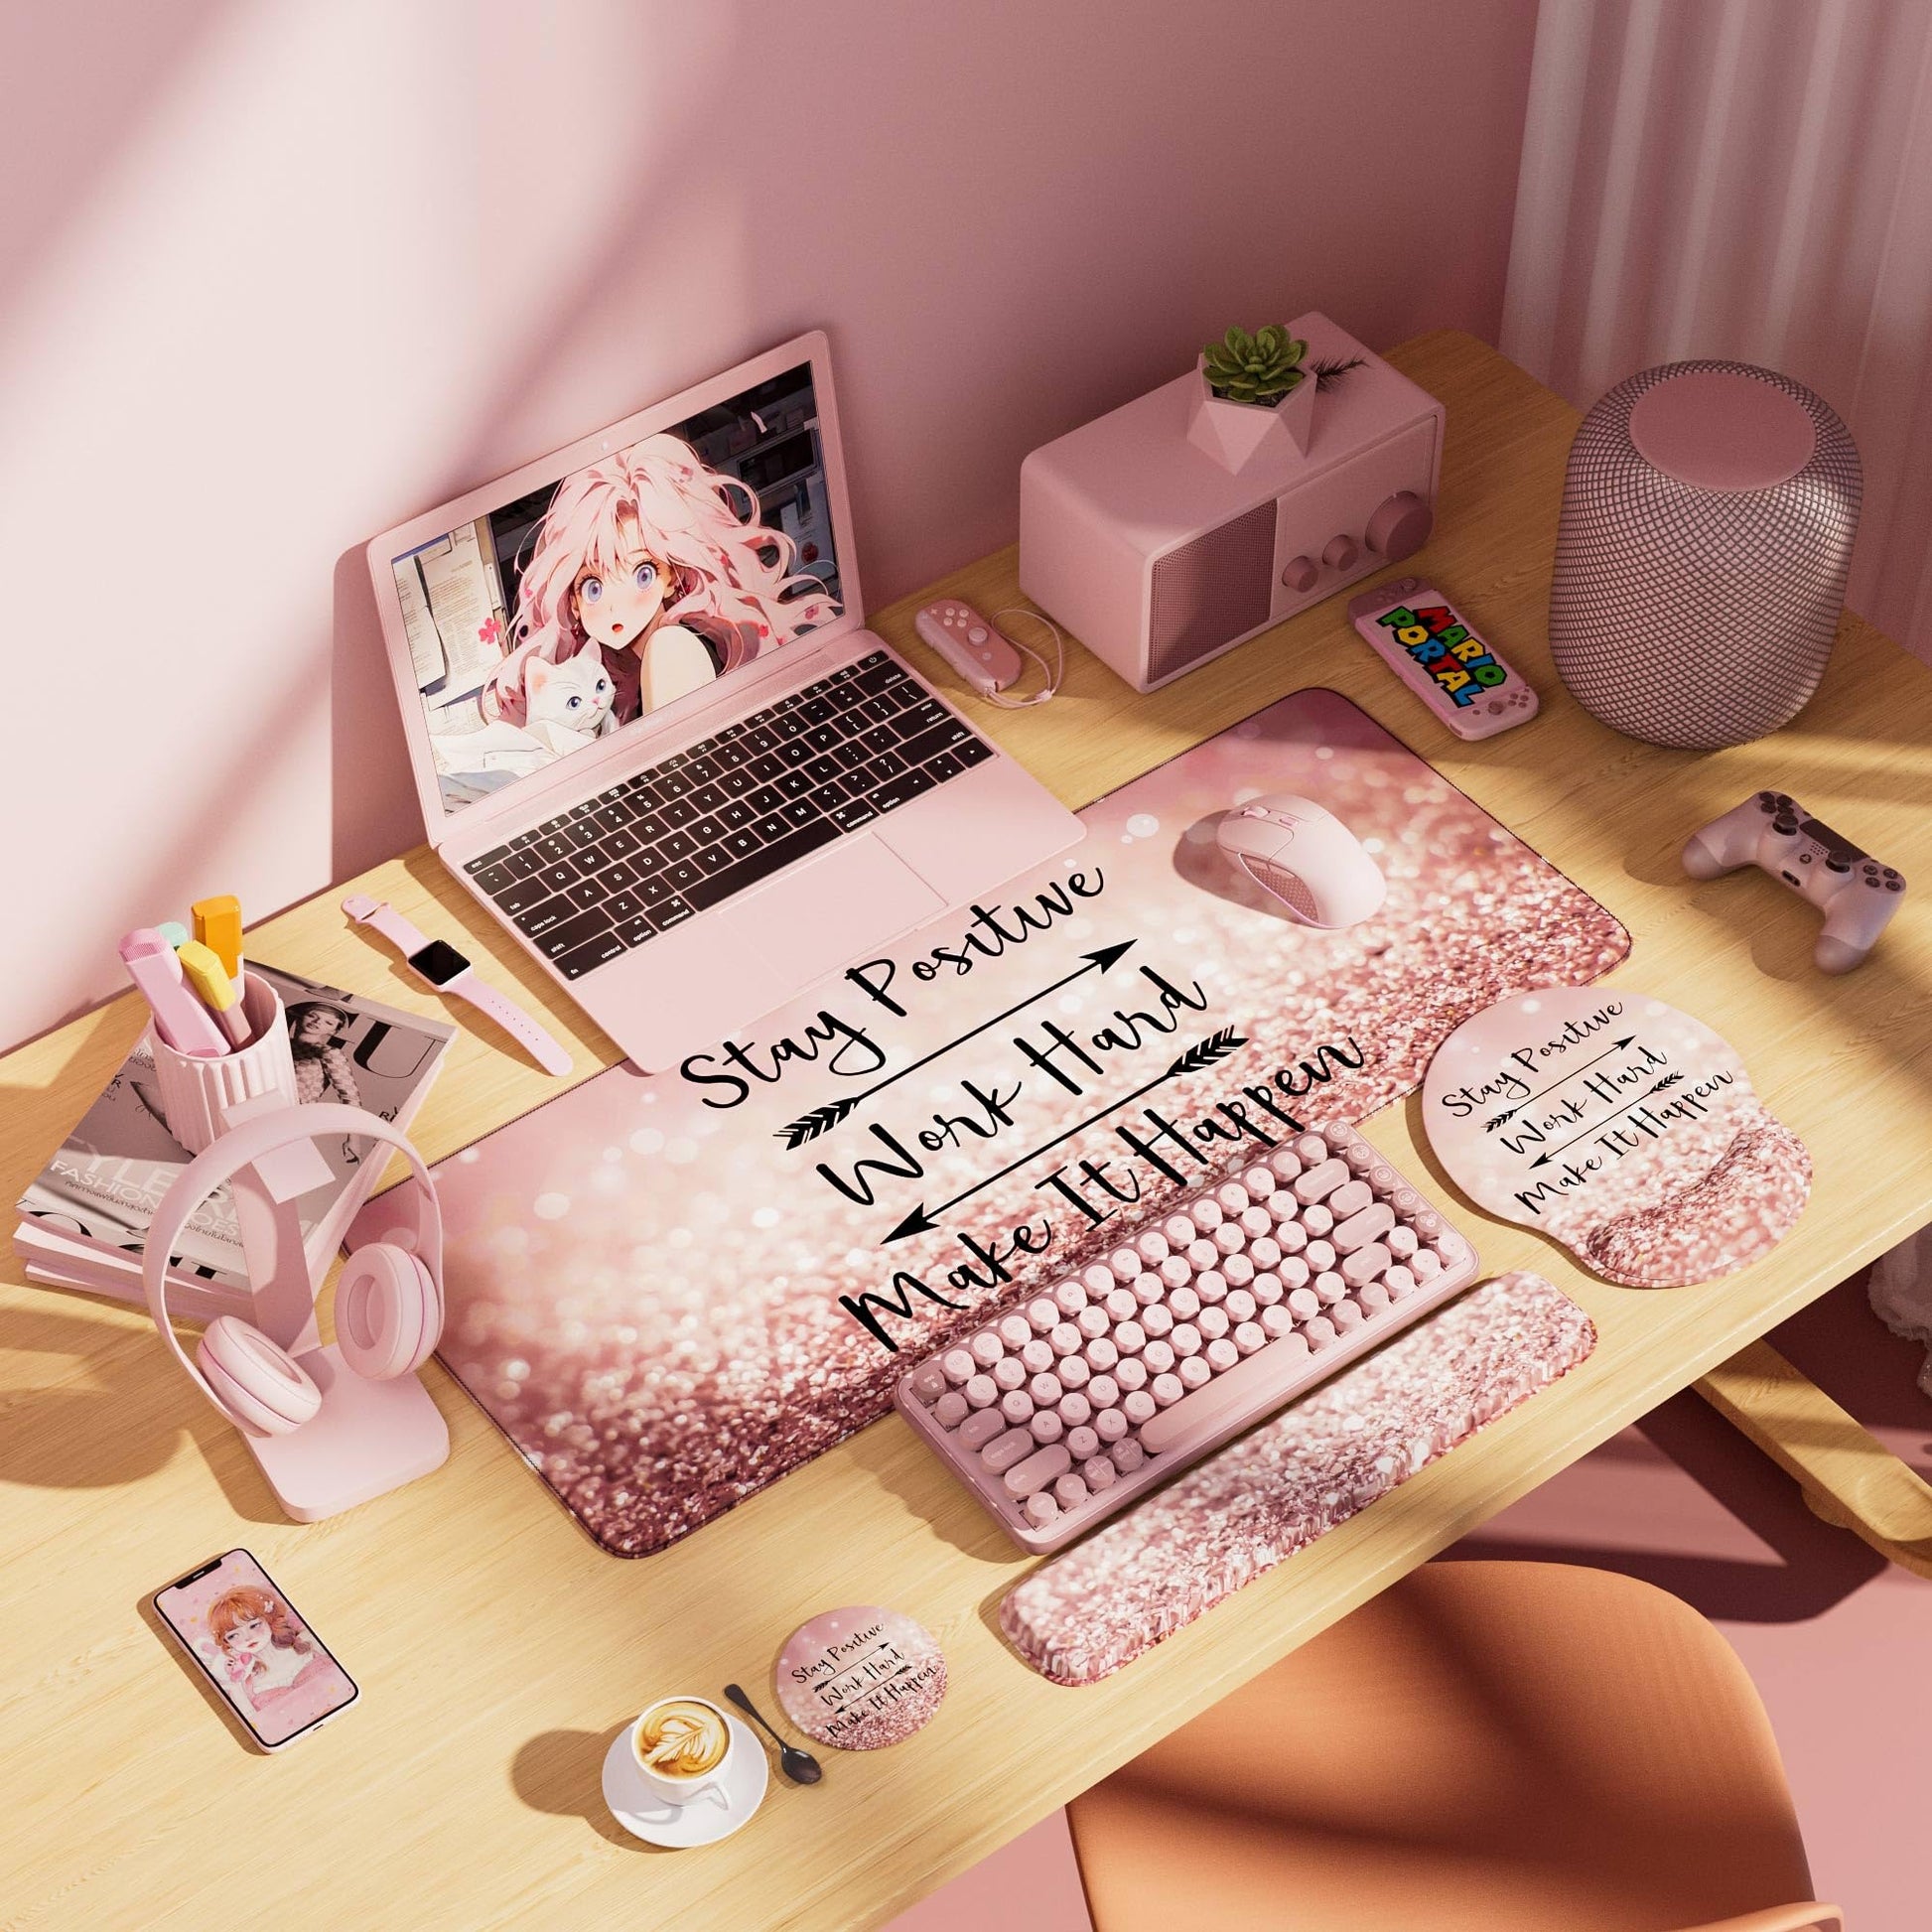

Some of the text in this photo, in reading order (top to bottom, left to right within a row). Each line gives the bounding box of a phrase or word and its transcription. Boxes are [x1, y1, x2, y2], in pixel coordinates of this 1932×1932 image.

[1413, 606, 1508, 687] MARIO
[1376, 606, 1485, 708] PORTAL
[885, 673, 901, 684] delete
[926, 712, 944, 723] return
[952, 731, 965, 740] shift
[882, 797, 900, 809] option
[796, 808, 807, 817] M
[846, 811, 873, 828] command
[583, 855, 595, 864] W
[648, 885, 659, 894] X
[531, 915, 557, 931] caps lock
[662, 909, 690, 926] command
[633, 929, 652, 942] option
[551, 943, 565, 953] shift
[601, 945, 621, 959] control
[681, 866, 1104, 1109] Stay Positive
[1442, 1002, 1623, 1117] Stay Positive
[816, 966, 1207, 1205] Work Hard
[1500, 1046, 1667, 1154] Work Hard
[1514, 1070, 1733, 1214] Make It Happen
[838, 1033, 1366, 1353] Make It Happen
[791, 1623, 884, 1683] Stay Positive
[821, 1649, 904, 1706] Work Hard
[825, 1666, 938, 1738] Make It Happen
